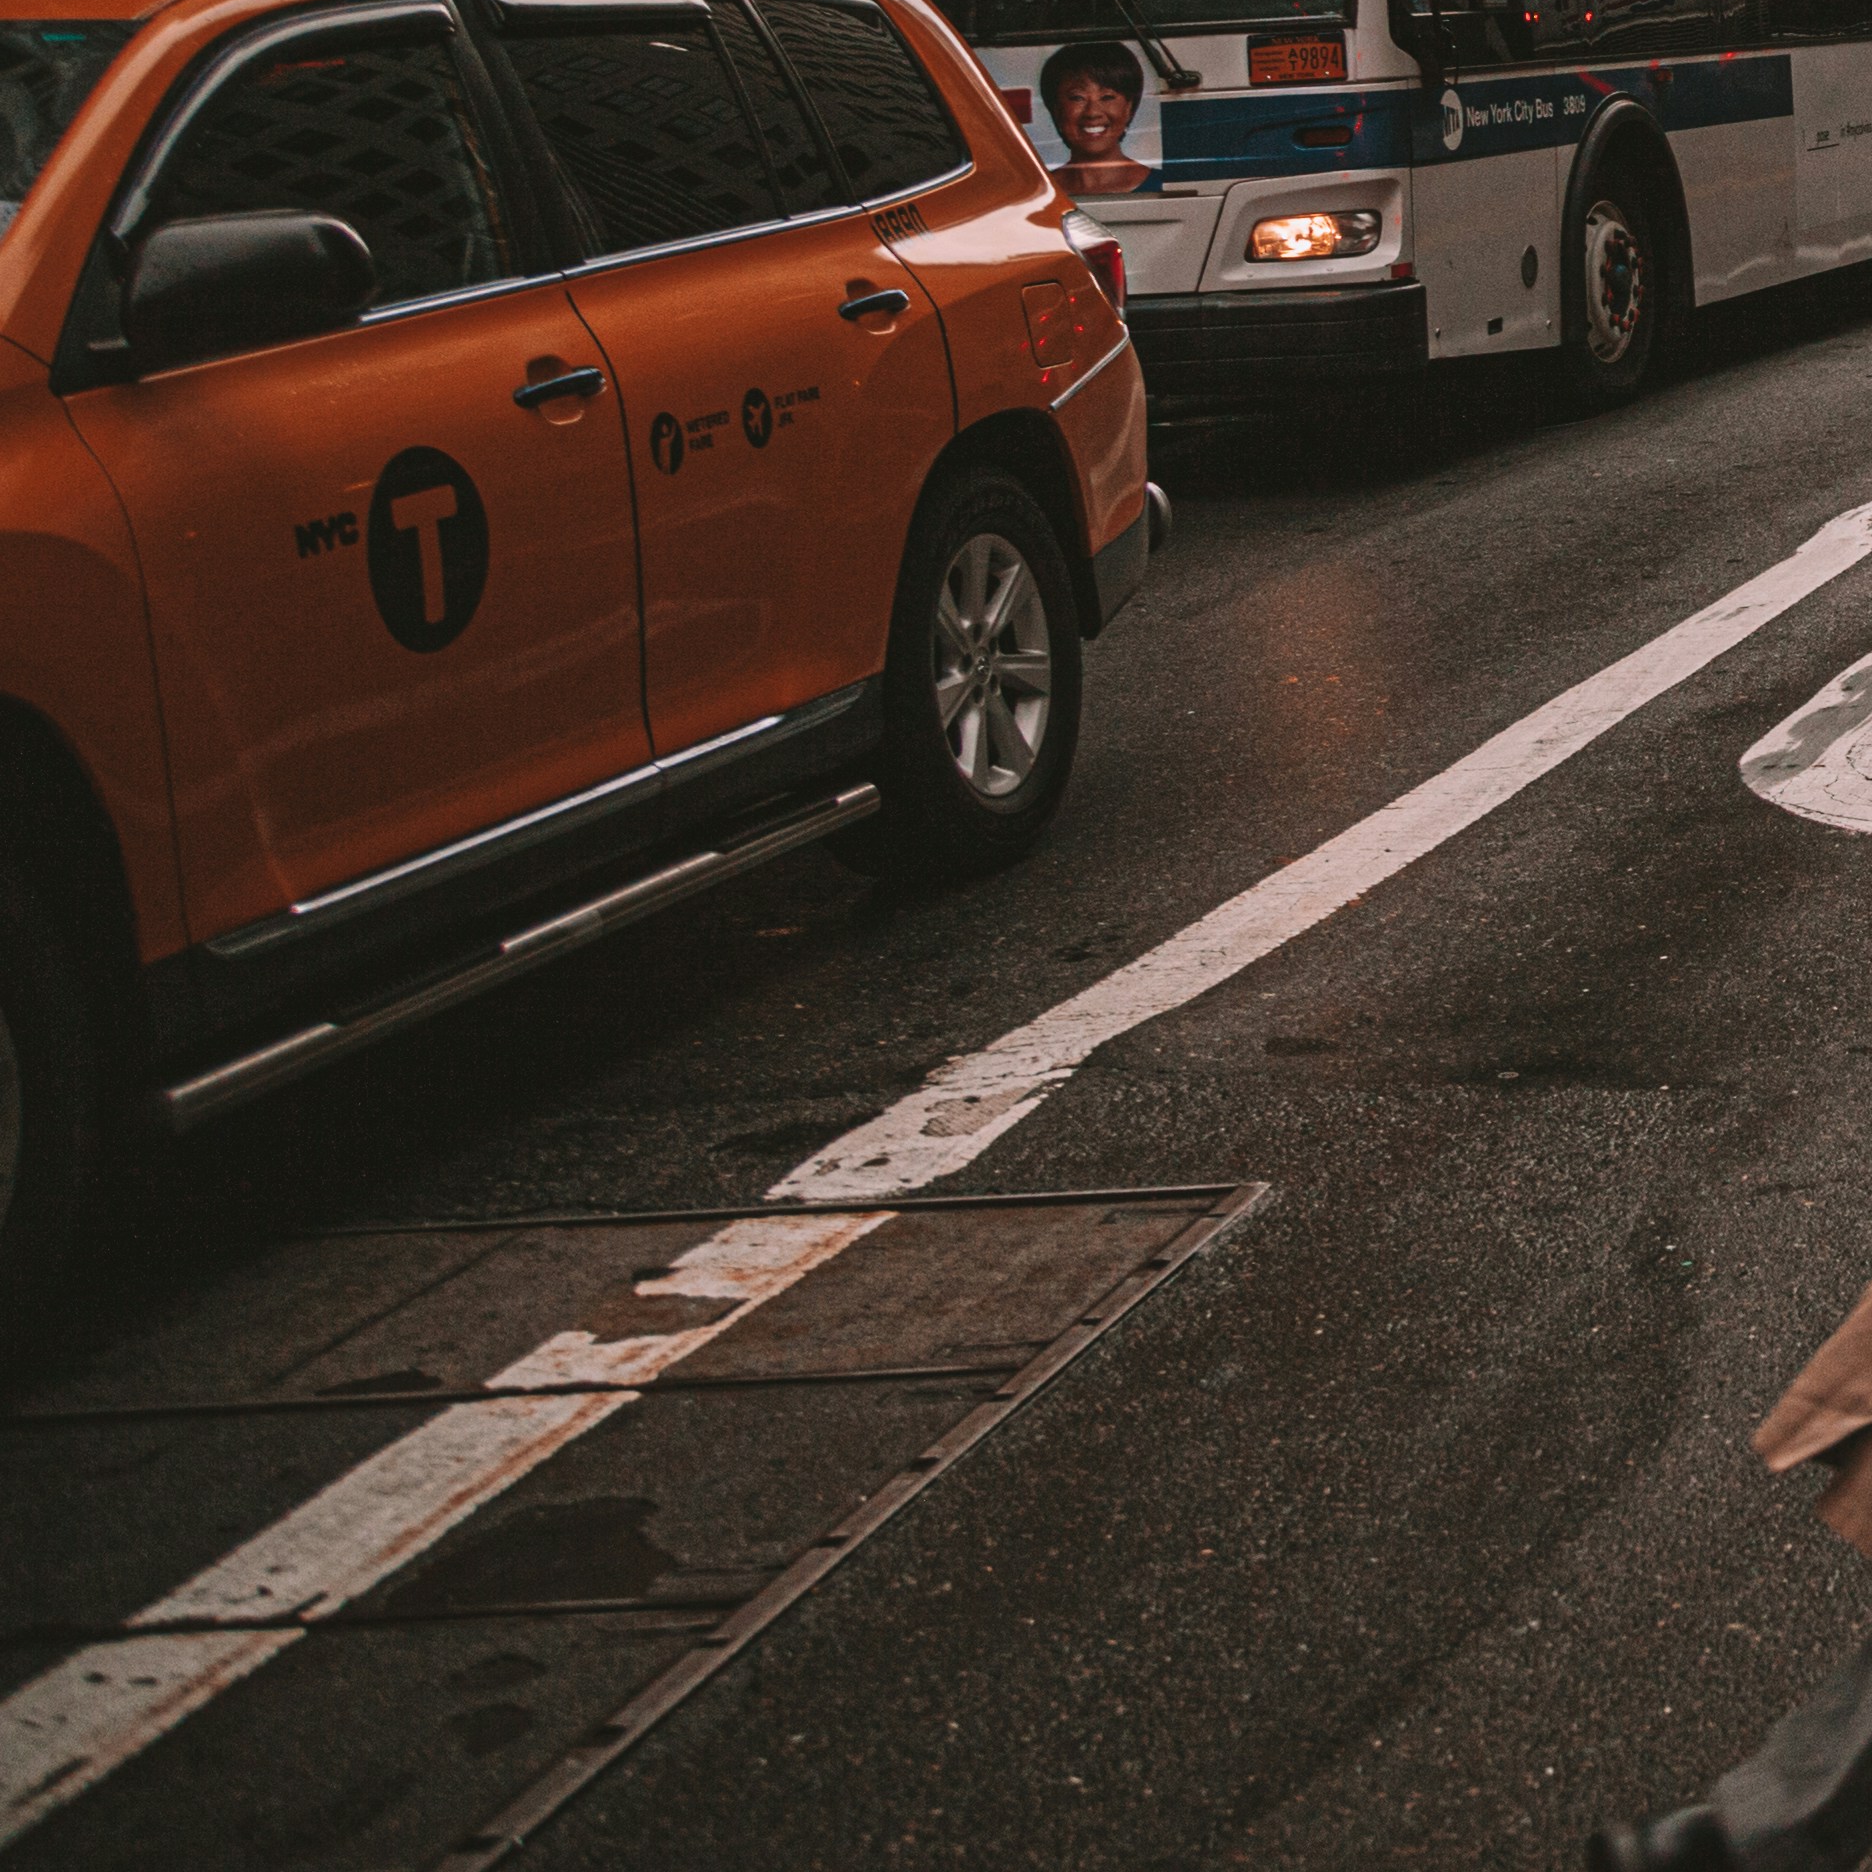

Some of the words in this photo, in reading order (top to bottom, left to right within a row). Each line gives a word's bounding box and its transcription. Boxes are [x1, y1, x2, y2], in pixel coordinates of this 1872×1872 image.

[1299, 46, 1340, 70] 9894
[1466, 107, 1489, 127] New
[1490, 102, 1513, 124] York
[1514, 99, 1533, 124] City
[1535, 98, 1554, 119] Bus
[1563, 94, 1586, 116] 3809
[295, 511, 359, 559] NYC
